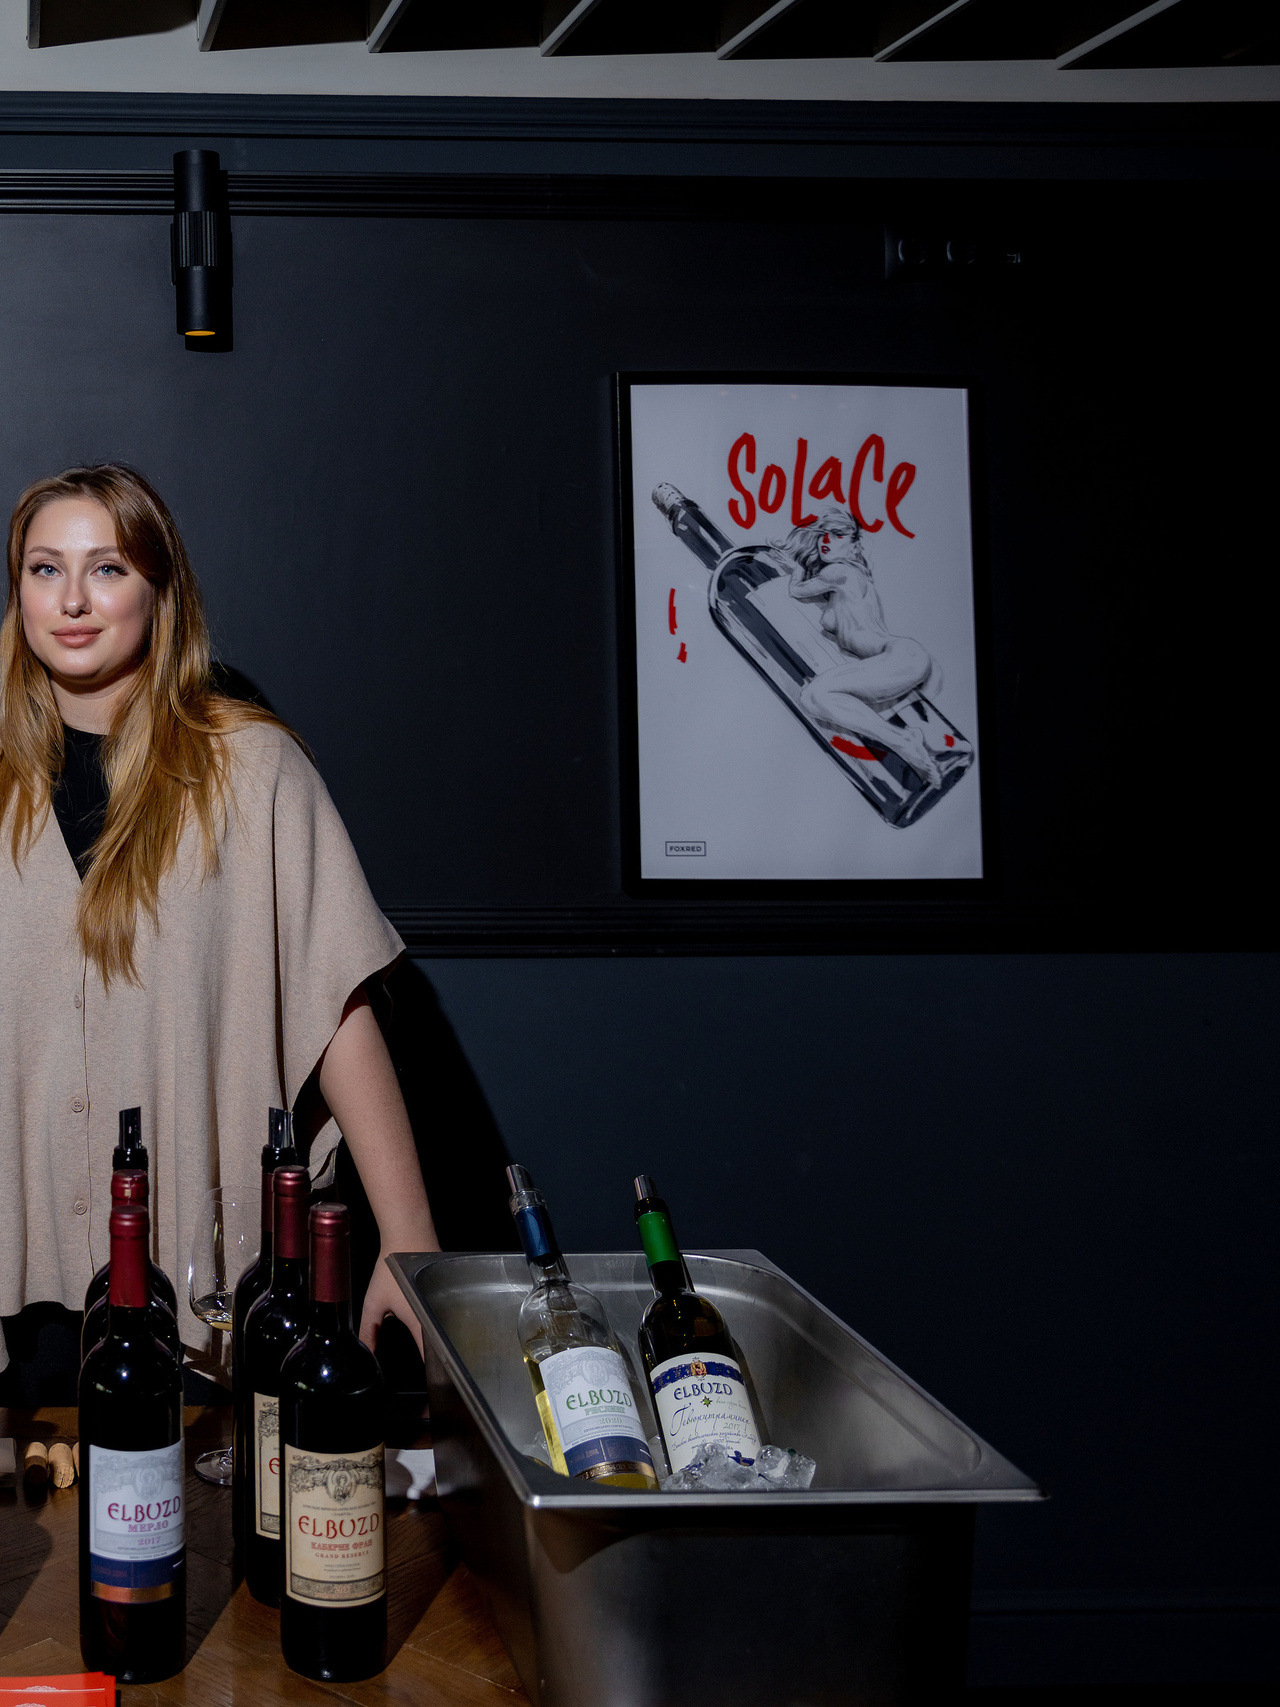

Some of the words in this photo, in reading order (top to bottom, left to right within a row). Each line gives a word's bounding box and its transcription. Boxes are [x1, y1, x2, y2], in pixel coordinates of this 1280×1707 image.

[669, 844, 703, 854] FOXRED
[673, 1382, 733, 1400] ELBUZD
[565, 1388, 633, 1411] ELBUZD
[723, 1422, 741, 1431] 2017
[107, 1495, 181, 1523] ELBUZD
[298, 1512, 380, 1540] ELBUZD
[137, 1536, 161, 1546] 2017
[341, 1550, 370, 1559] RESERVE
